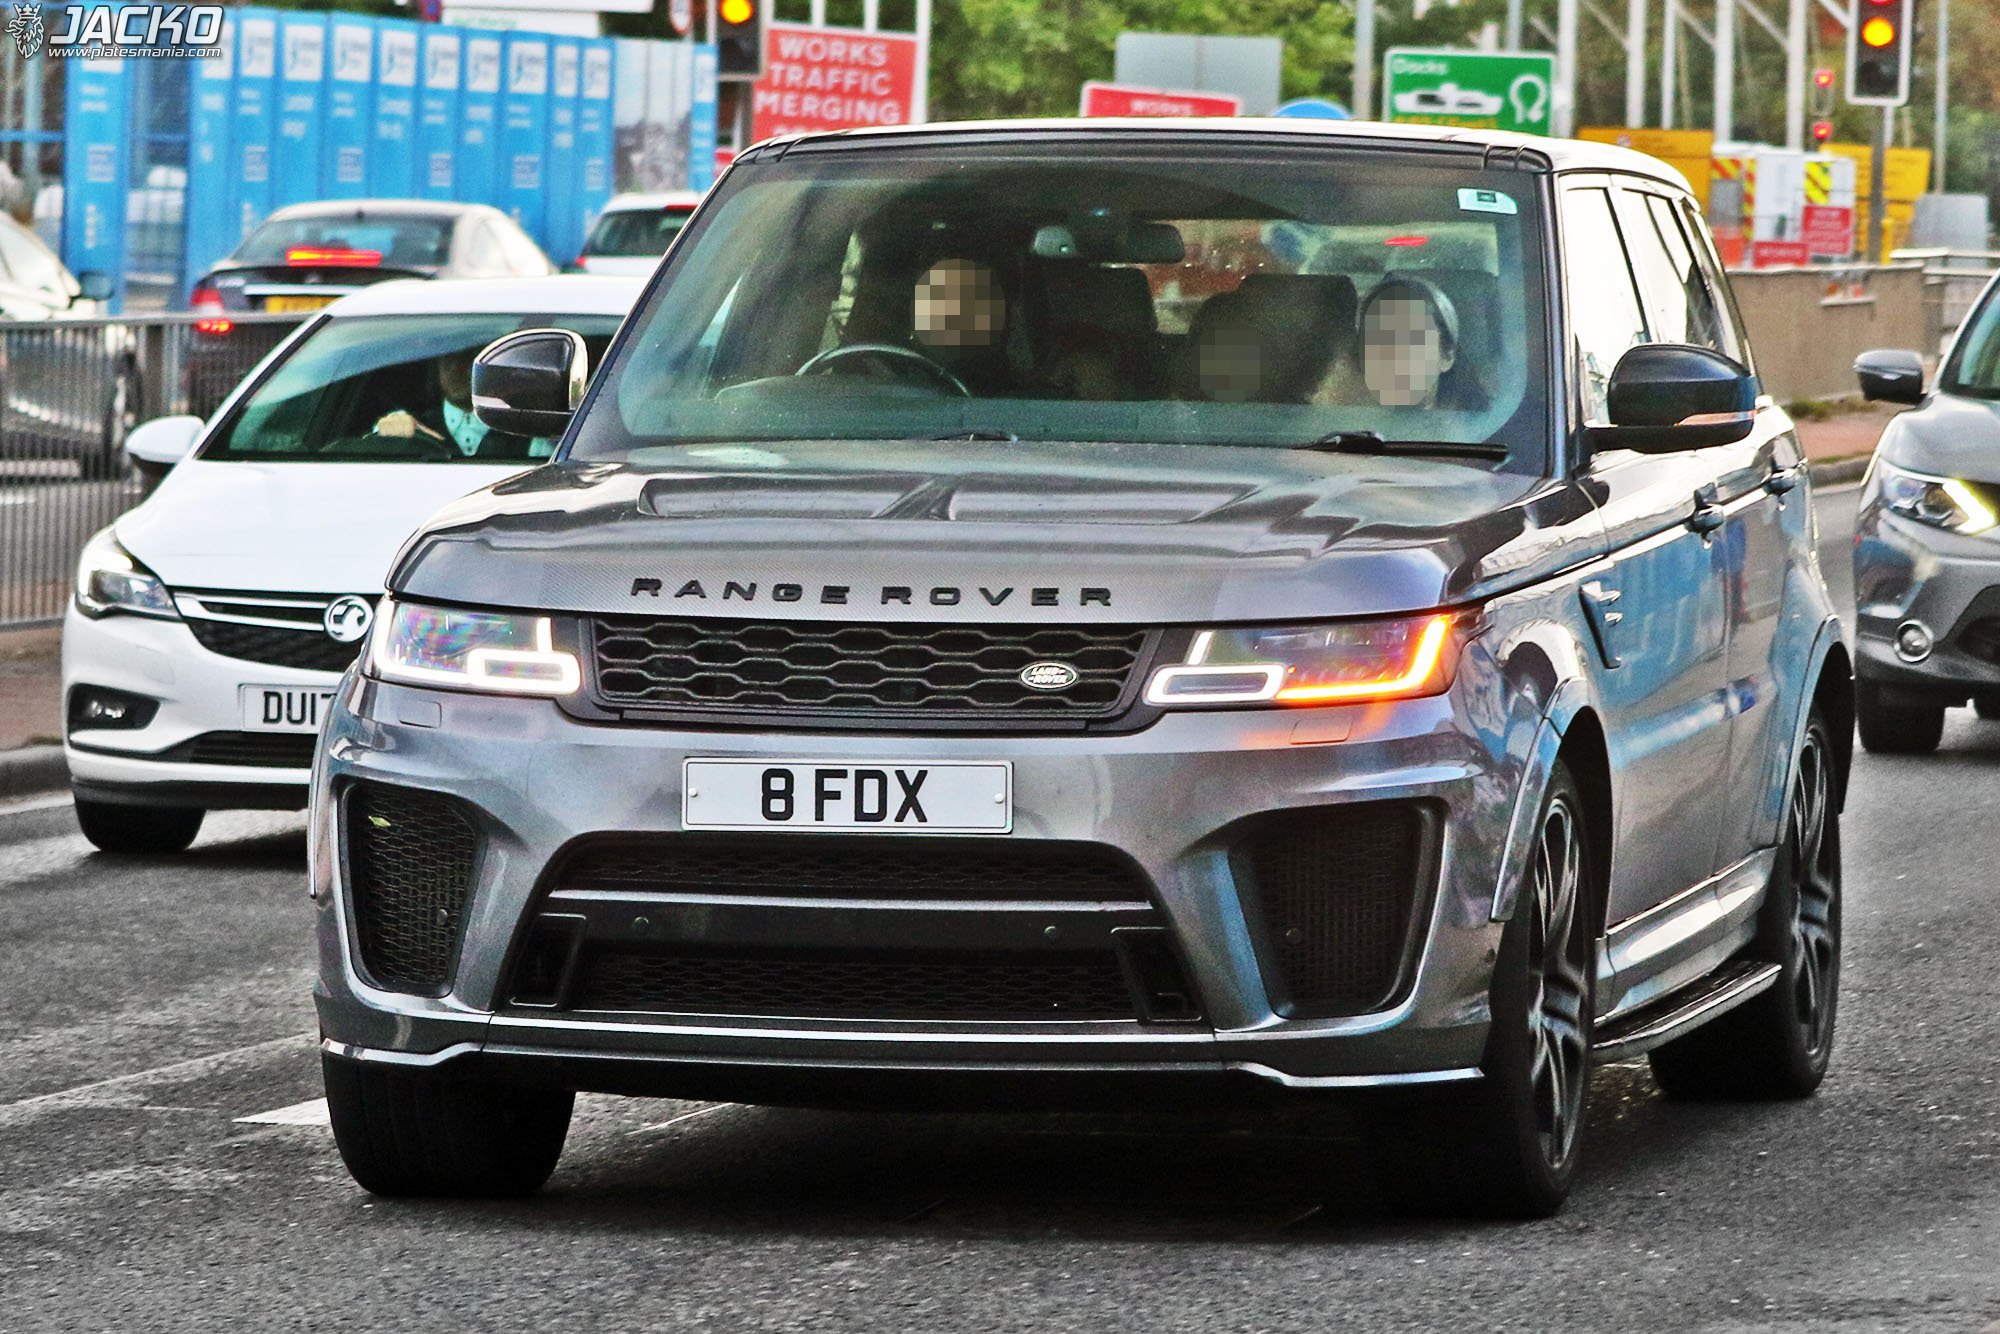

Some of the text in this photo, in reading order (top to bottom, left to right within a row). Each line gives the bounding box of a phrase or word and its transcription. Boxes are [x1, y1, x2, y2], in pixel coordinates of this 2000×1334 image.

[778, 35, 887, 67] WORKS
[769, 62, 893, 96] TRAFFIC
[754, 89, 900, 125] MERGING
[631, 578, 1112, 607] RANGE ROVER
[1031, 666, 1060, 675] LAND
[1033, 674, 1068, 684] ROVER
[761, 768, 928, 823] 8 FDX
